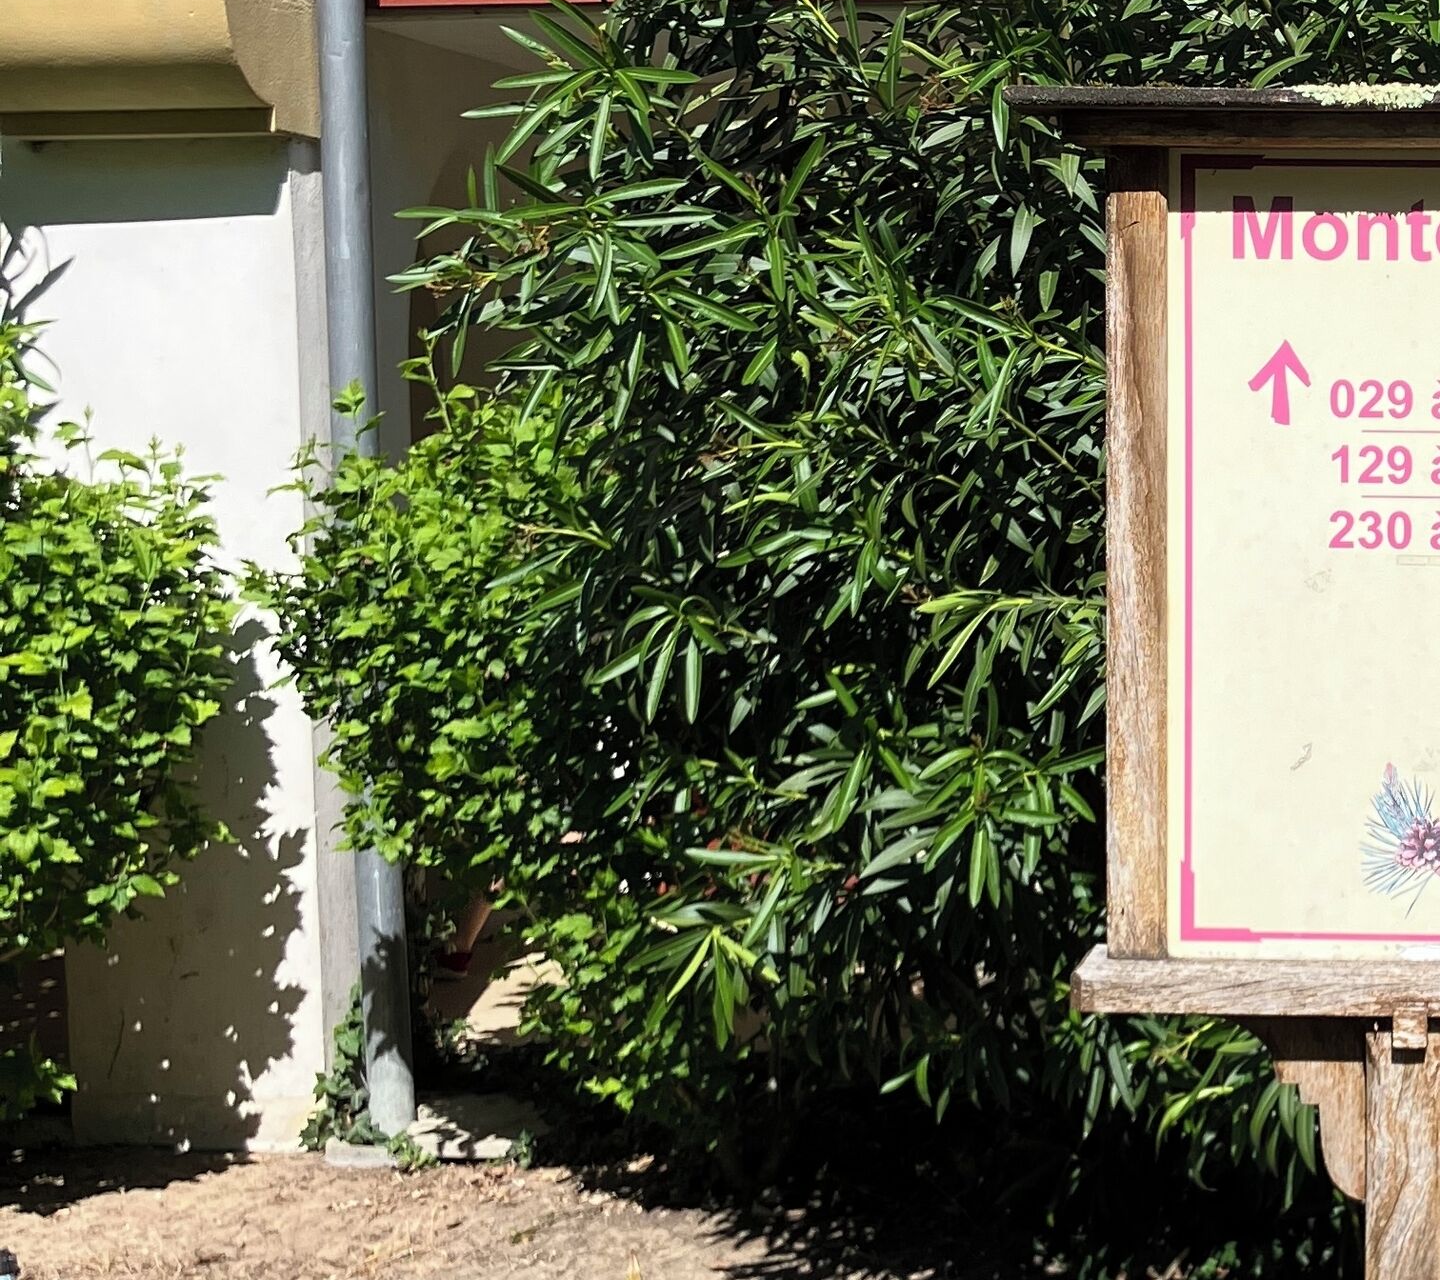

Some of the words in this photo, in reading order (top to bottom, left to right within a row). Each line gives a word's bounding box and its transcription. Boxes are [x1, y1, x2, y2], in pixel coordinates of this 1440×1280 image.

[1330, 379, 1414, 419] 029
[1331, 444, 1414, 484] 129
[1328, 510, 1413, 550] 230
